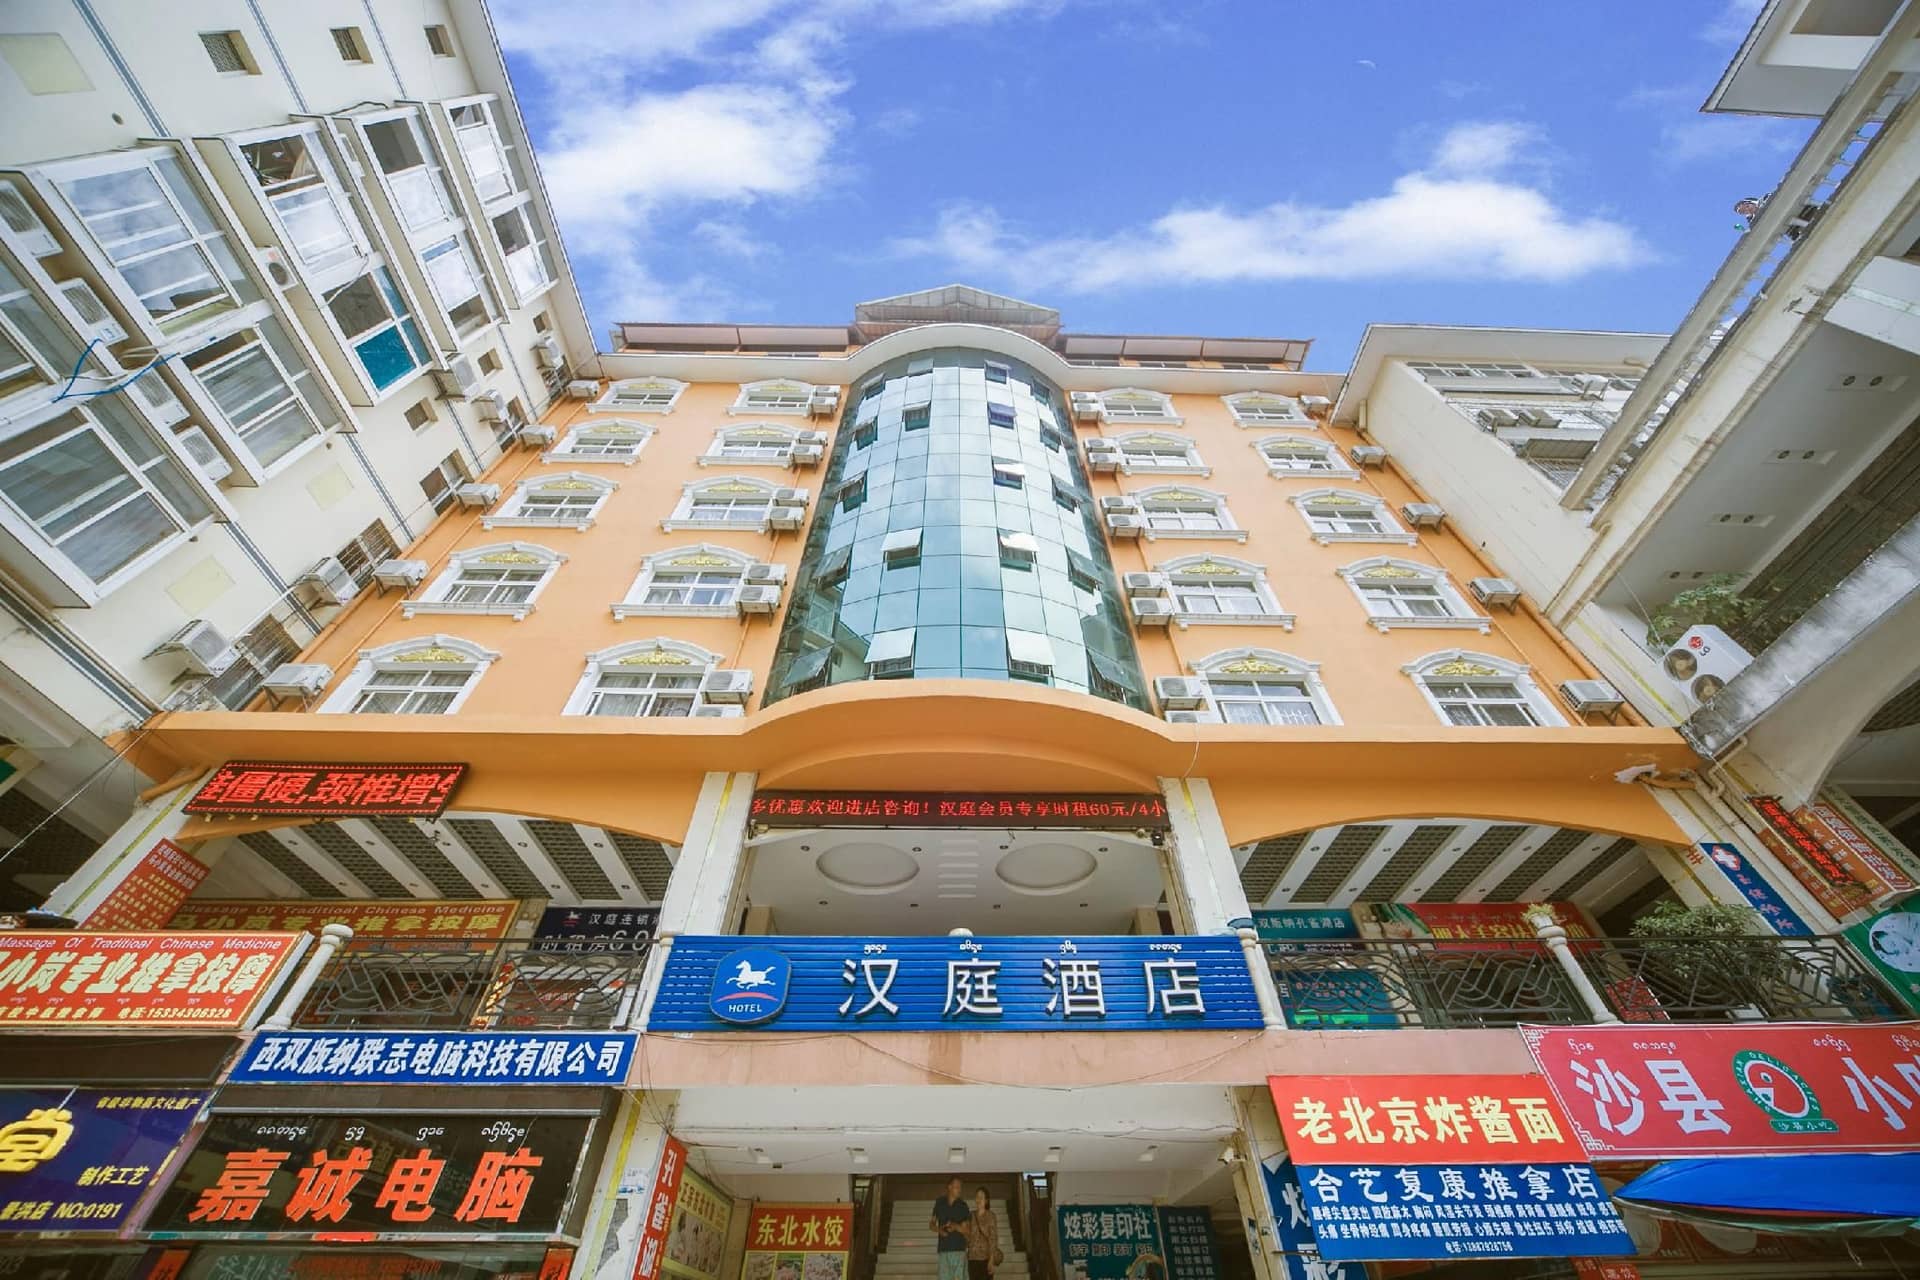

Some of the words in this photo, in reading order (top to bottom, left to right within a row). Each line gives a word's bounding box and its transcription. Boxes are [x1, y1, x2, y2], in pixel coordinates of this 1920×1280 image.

[940, 800, 1165, 817] 汉庭会员专享时租60元/4小
[365, 904, 426, 915] Chinese
[434, 904, 506, 915] Medicine
[0, 937, 56, 951] Massage
[64, 937, 83, 949] Of
[160, 938, 214, 950] Chinese
[222, 938, 282, 950] Medicine
[839, 957, 1206, 1016] 汉庭酒店
[728, 1004, 763, 1013] HOTEL
[248, 1037, 625, 1077] 西双版纳联志电脑科技有限公司
[1570, 1058, 1732, 1136] 沙县
[1292, 1096, 1564, 1144] 老北京炸酱面
[77, 1166, 150, 1186] 制作工艺
[188, 1147, 543, 1223] 嘉诚电脑
[1309, 1164, 1599, 1203] 合艺复康推拿店
[53, 1202, 123, 1219] NO:0191
[1064, 1211, 1152, 1240] 炫彩复印社
[755, 1213, 844, 1247] 东北水饺
